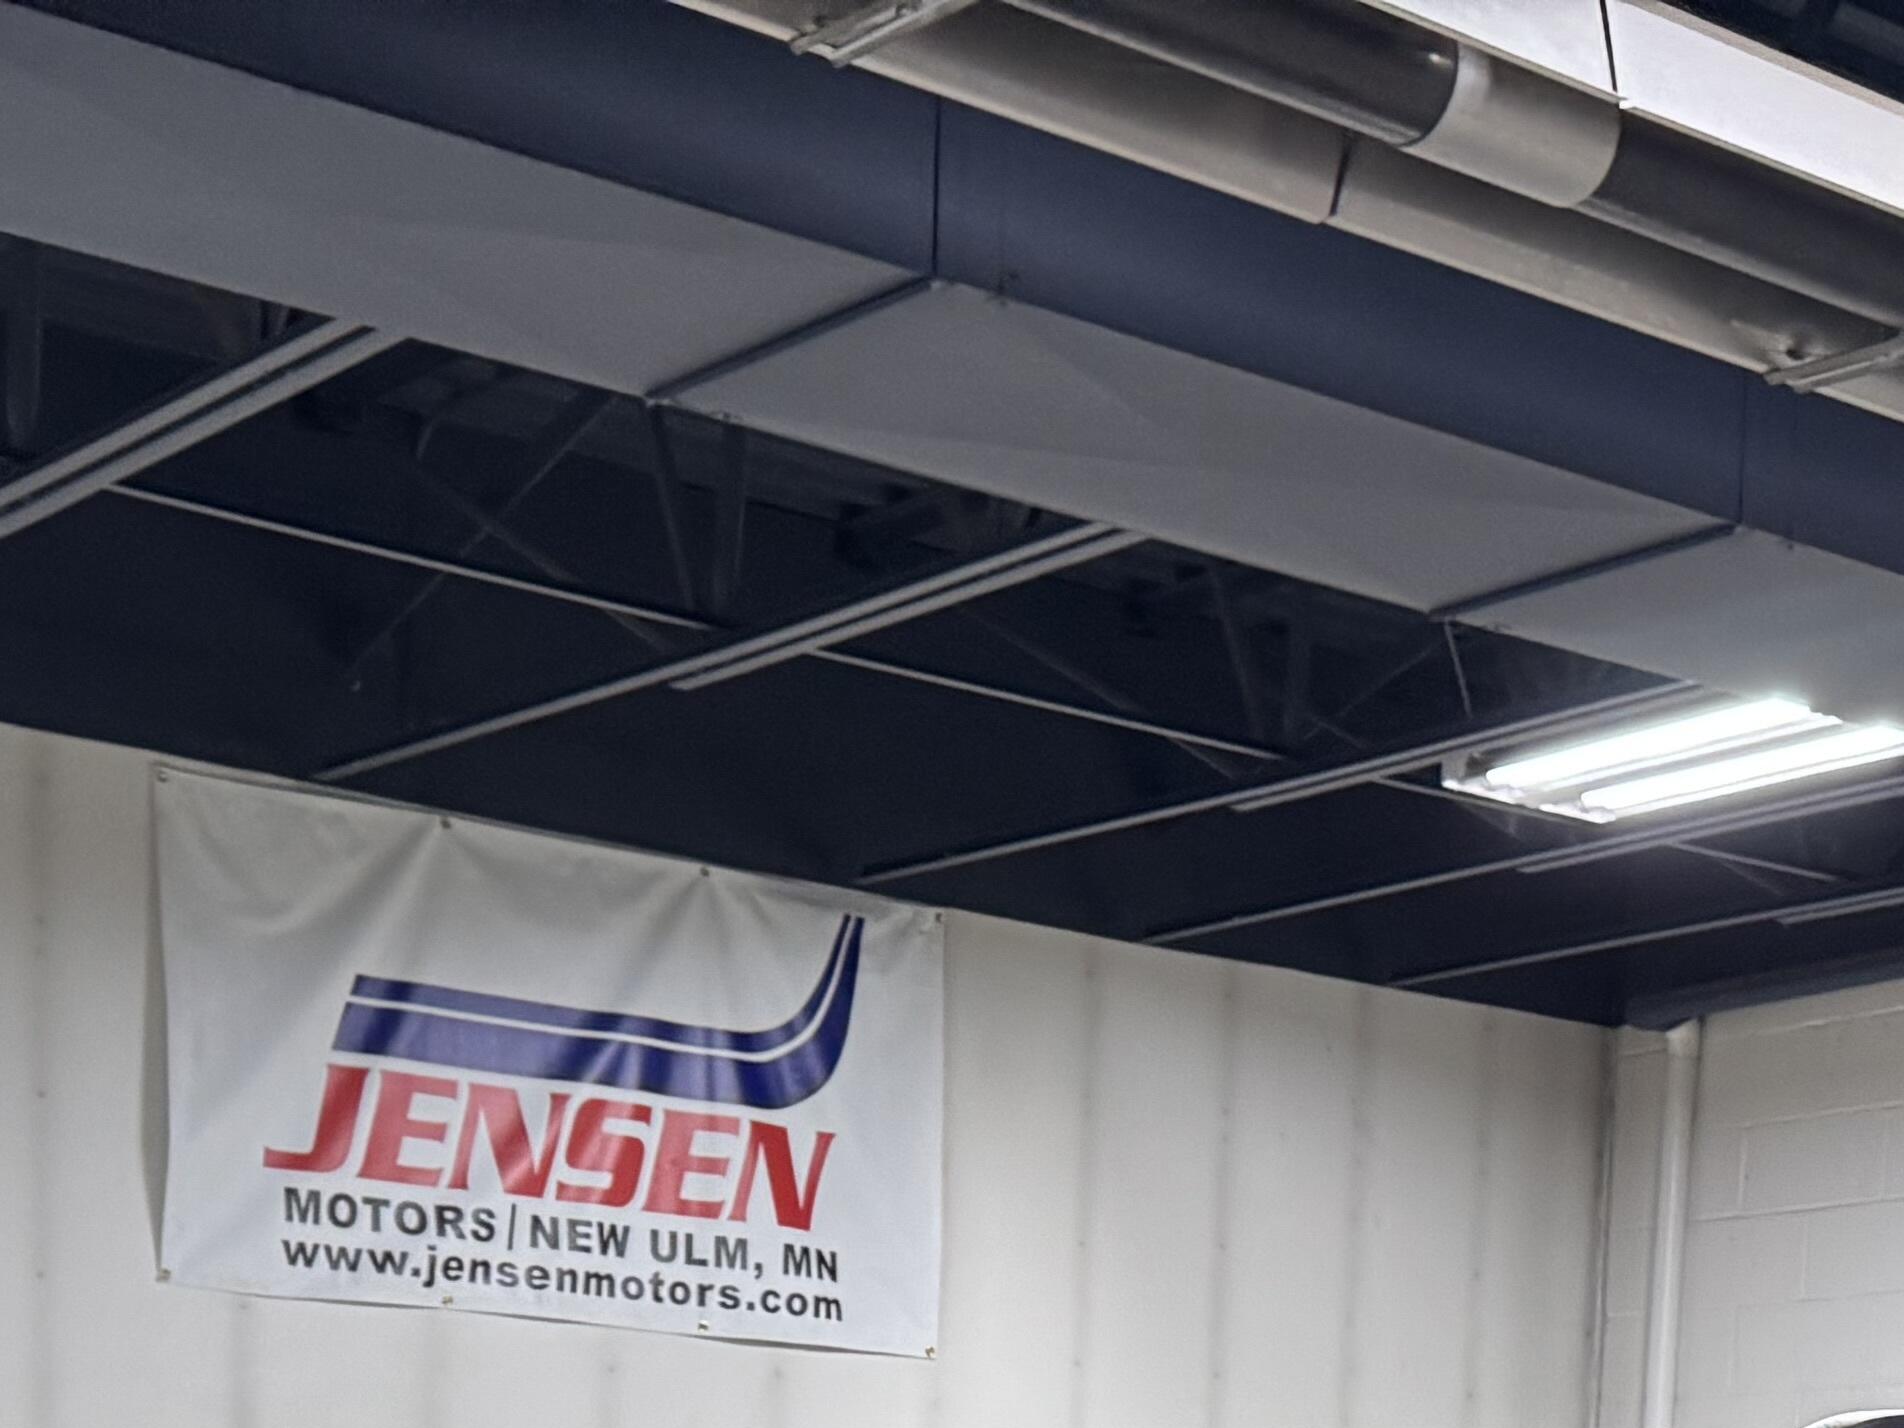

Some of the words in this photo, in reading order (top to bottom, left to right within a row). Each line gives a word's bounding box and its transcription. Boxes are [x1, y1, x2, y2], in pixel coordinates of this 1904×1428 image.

[262, 1063, 837, 1231] JENSEN
[281, 1239, 844, 1322] www.jensenmotors.com
[283, 1186, 497, 1243] MOTORS
[529, 1214, 631, 1258] NEW
[650, 1229, 764, 1280] ULM,
[782, 1242, 838, 1283] MN
